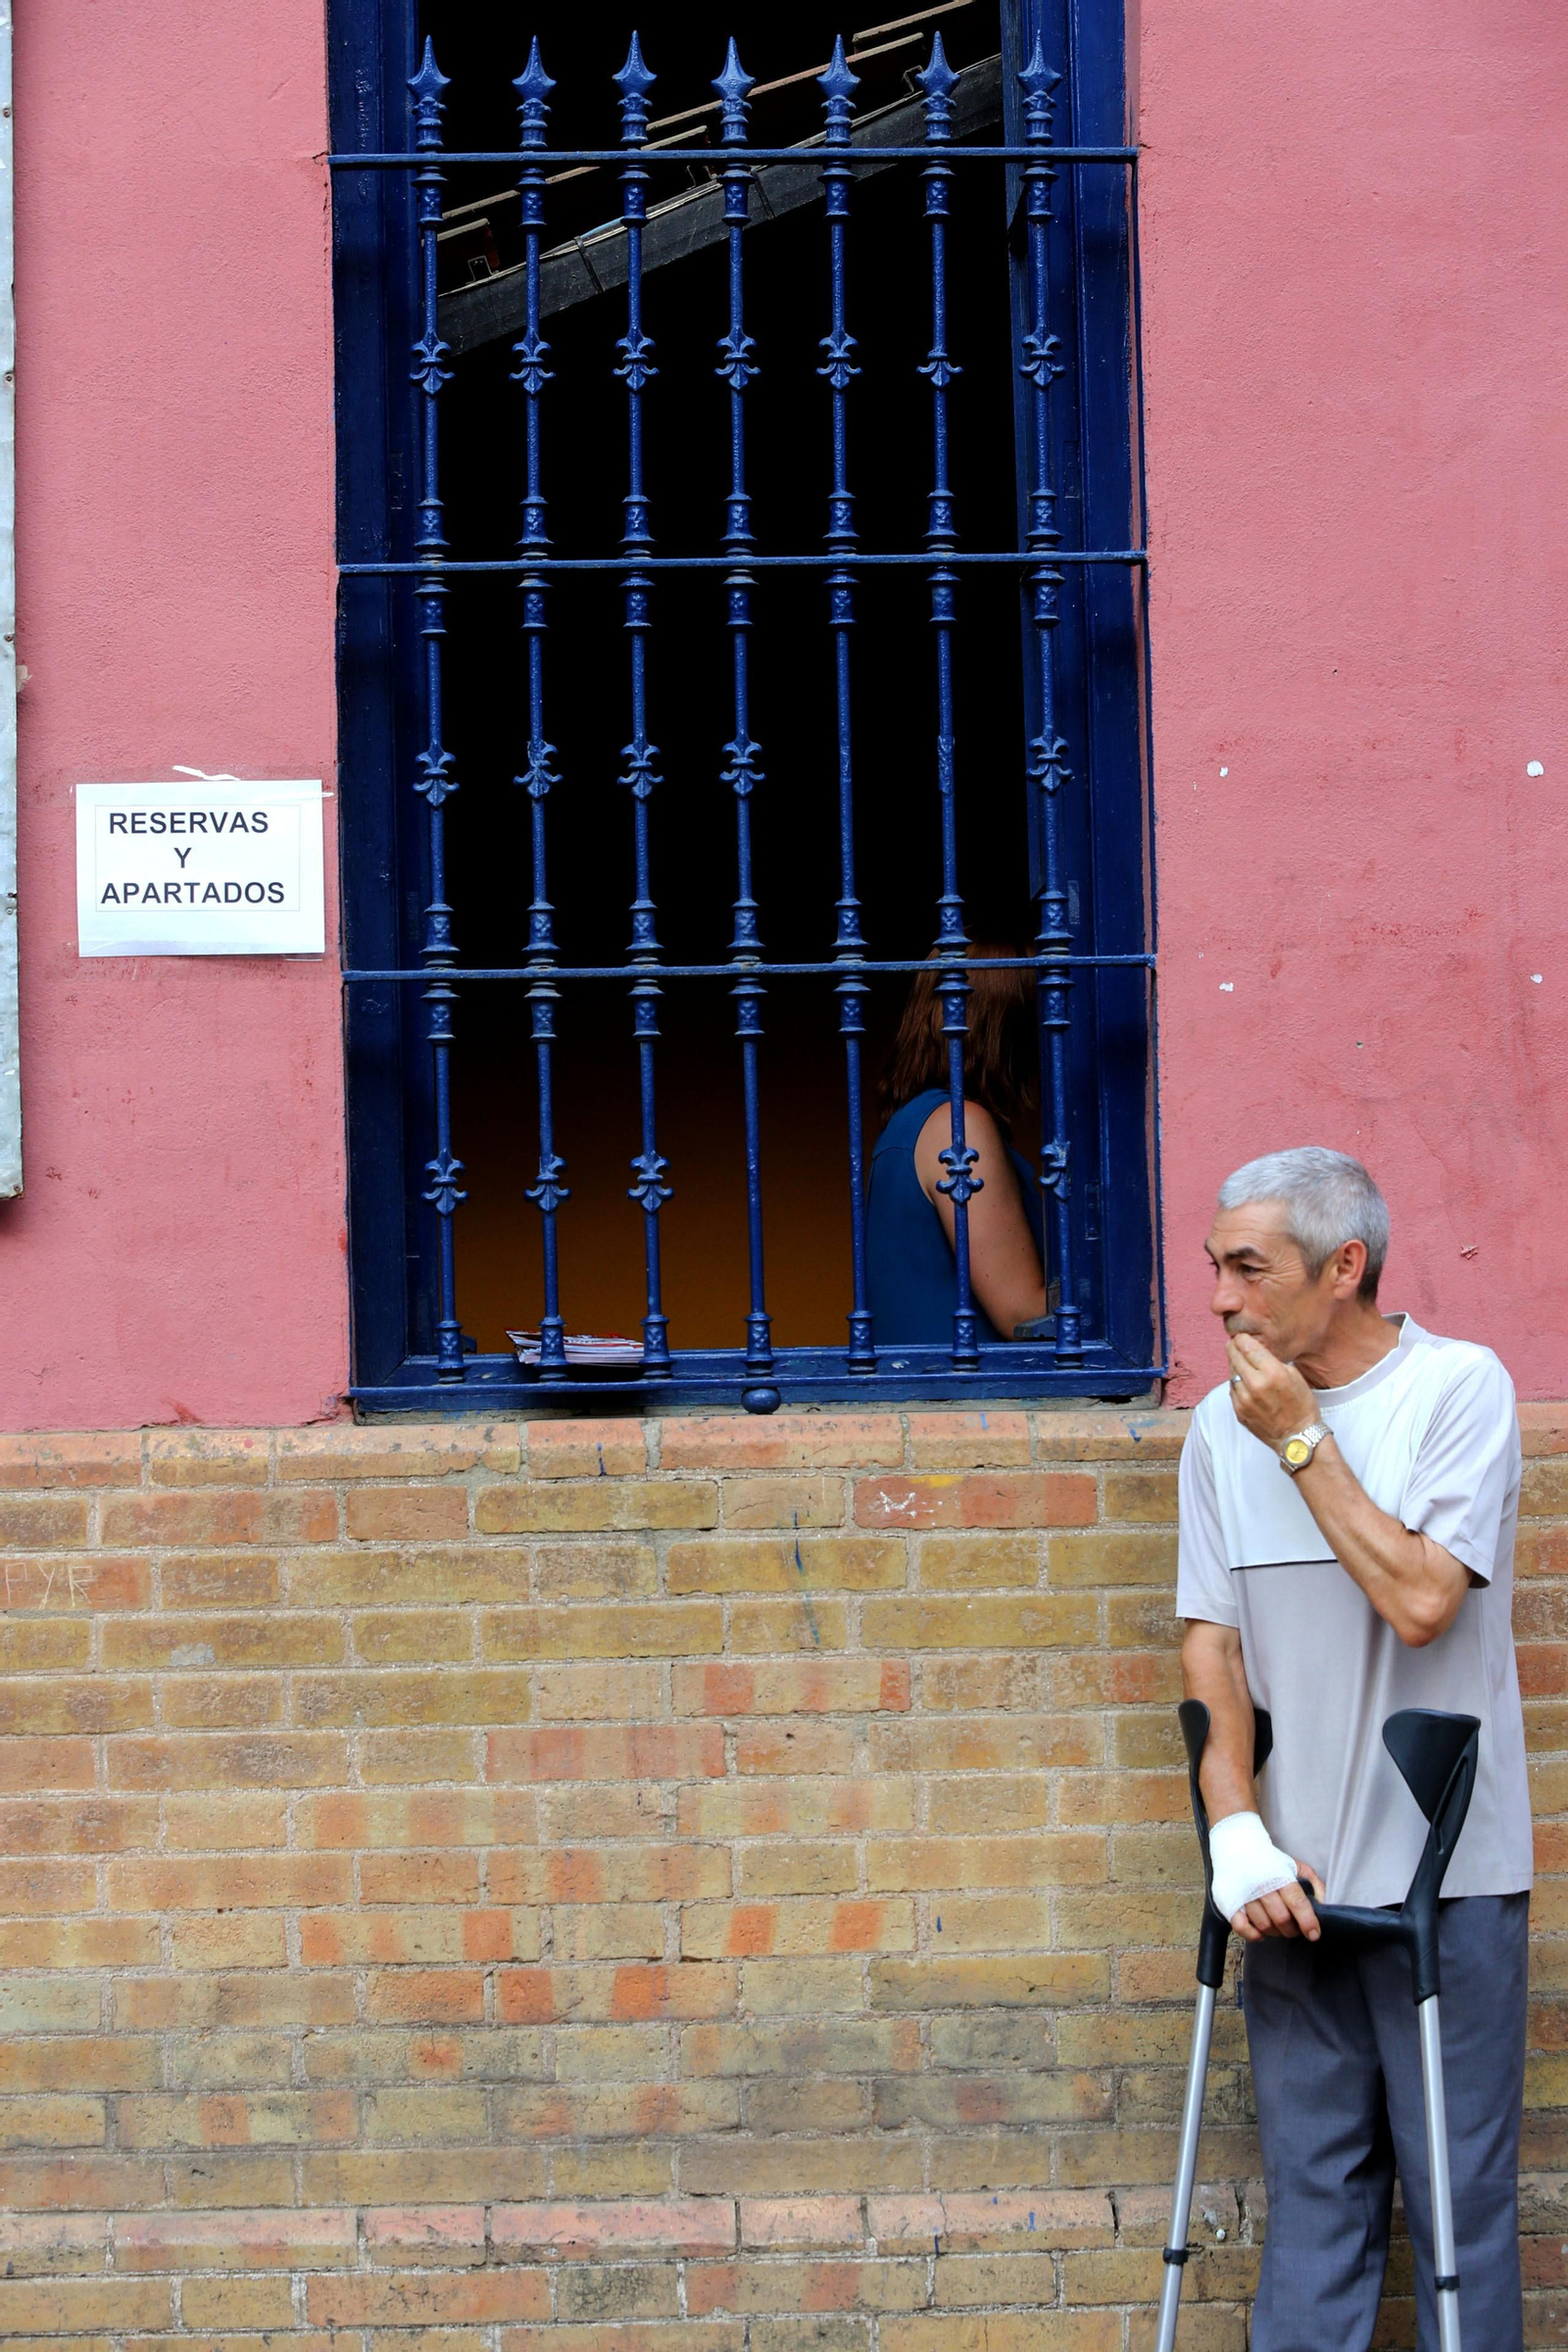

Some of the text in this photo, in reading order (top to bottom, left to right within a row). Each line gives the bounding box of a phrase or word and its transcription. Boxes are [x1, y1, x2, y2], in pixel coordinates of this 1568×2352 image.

[109, 810, 270, 835] RESERVAS
[172, 846, 193, 869] Y
[100, 880, 285, 905] APARTADOS
